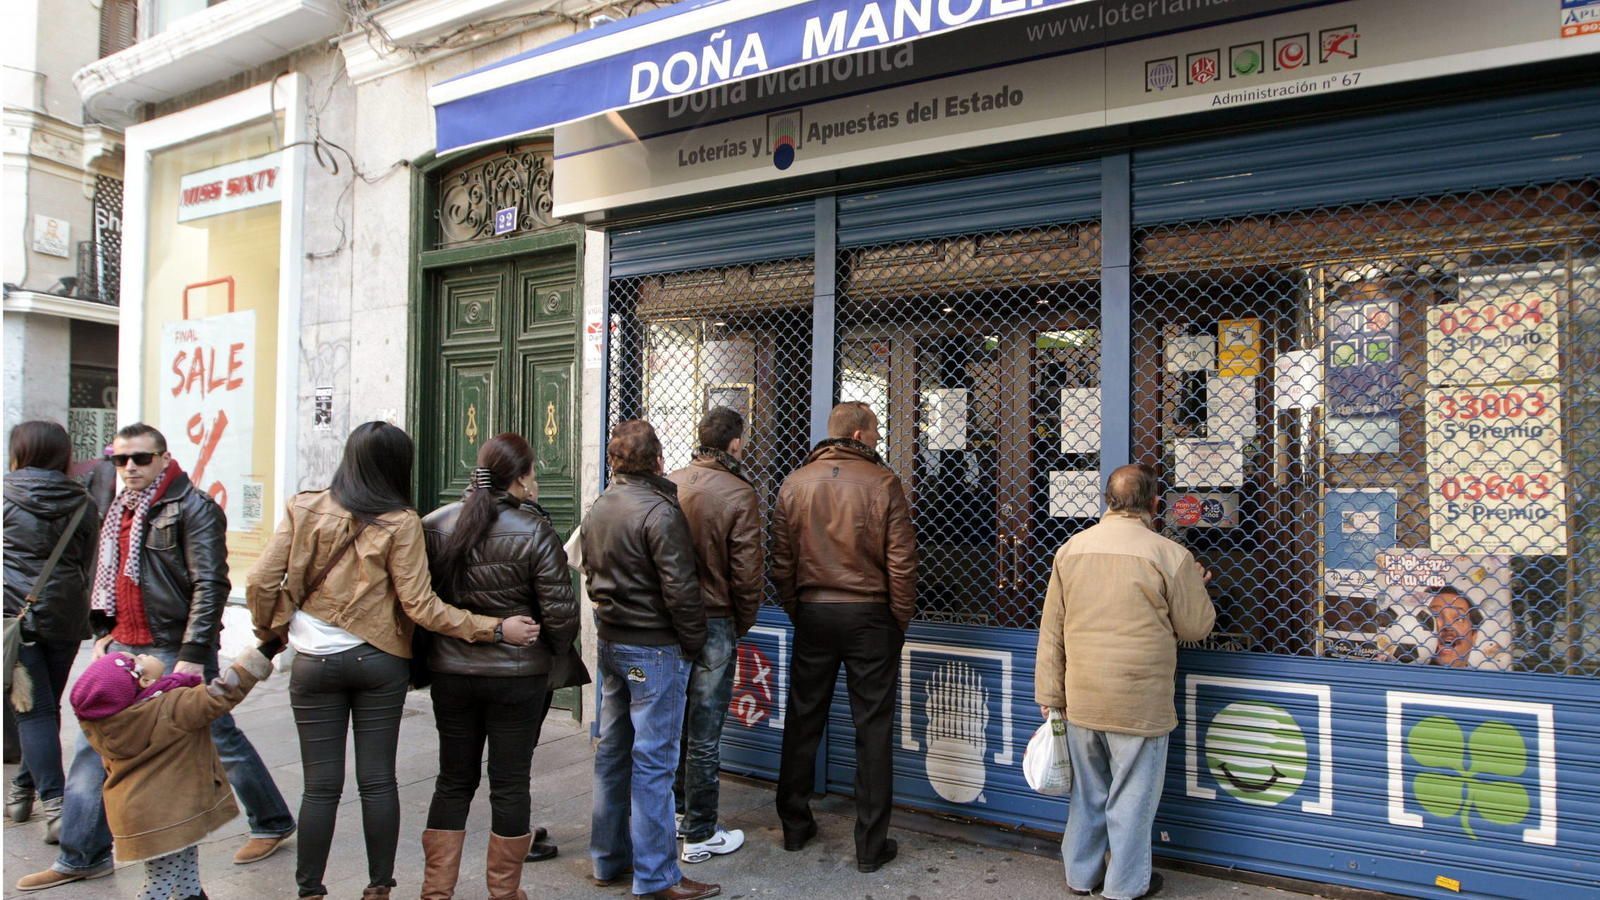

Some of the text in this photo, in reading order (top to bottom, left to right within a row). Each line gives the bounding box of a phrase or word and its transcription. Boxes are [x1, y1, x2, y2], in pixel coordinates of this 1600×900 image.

[629, 0, 1045, 103] DOÑA MANO
[1211, 80, 1318, 107] Administración
[1342, 72, 1362, 87] 67
[678, 85, 1024, 167] Loterías y Apuestas del Estado
[180, 166, 280, 208] MISS SIXTY
[499, 212, 513, 229] 22
[174, 329, 199, 344] FINAL
[171, 342, 244, 400] SALE
[1438, 392, 1546, 419] 33003
[1469, 421, 1543, 439] Premio
[1441, 474, 1549, 501] 03643
[1472, 503, 1548, 521] Premio
